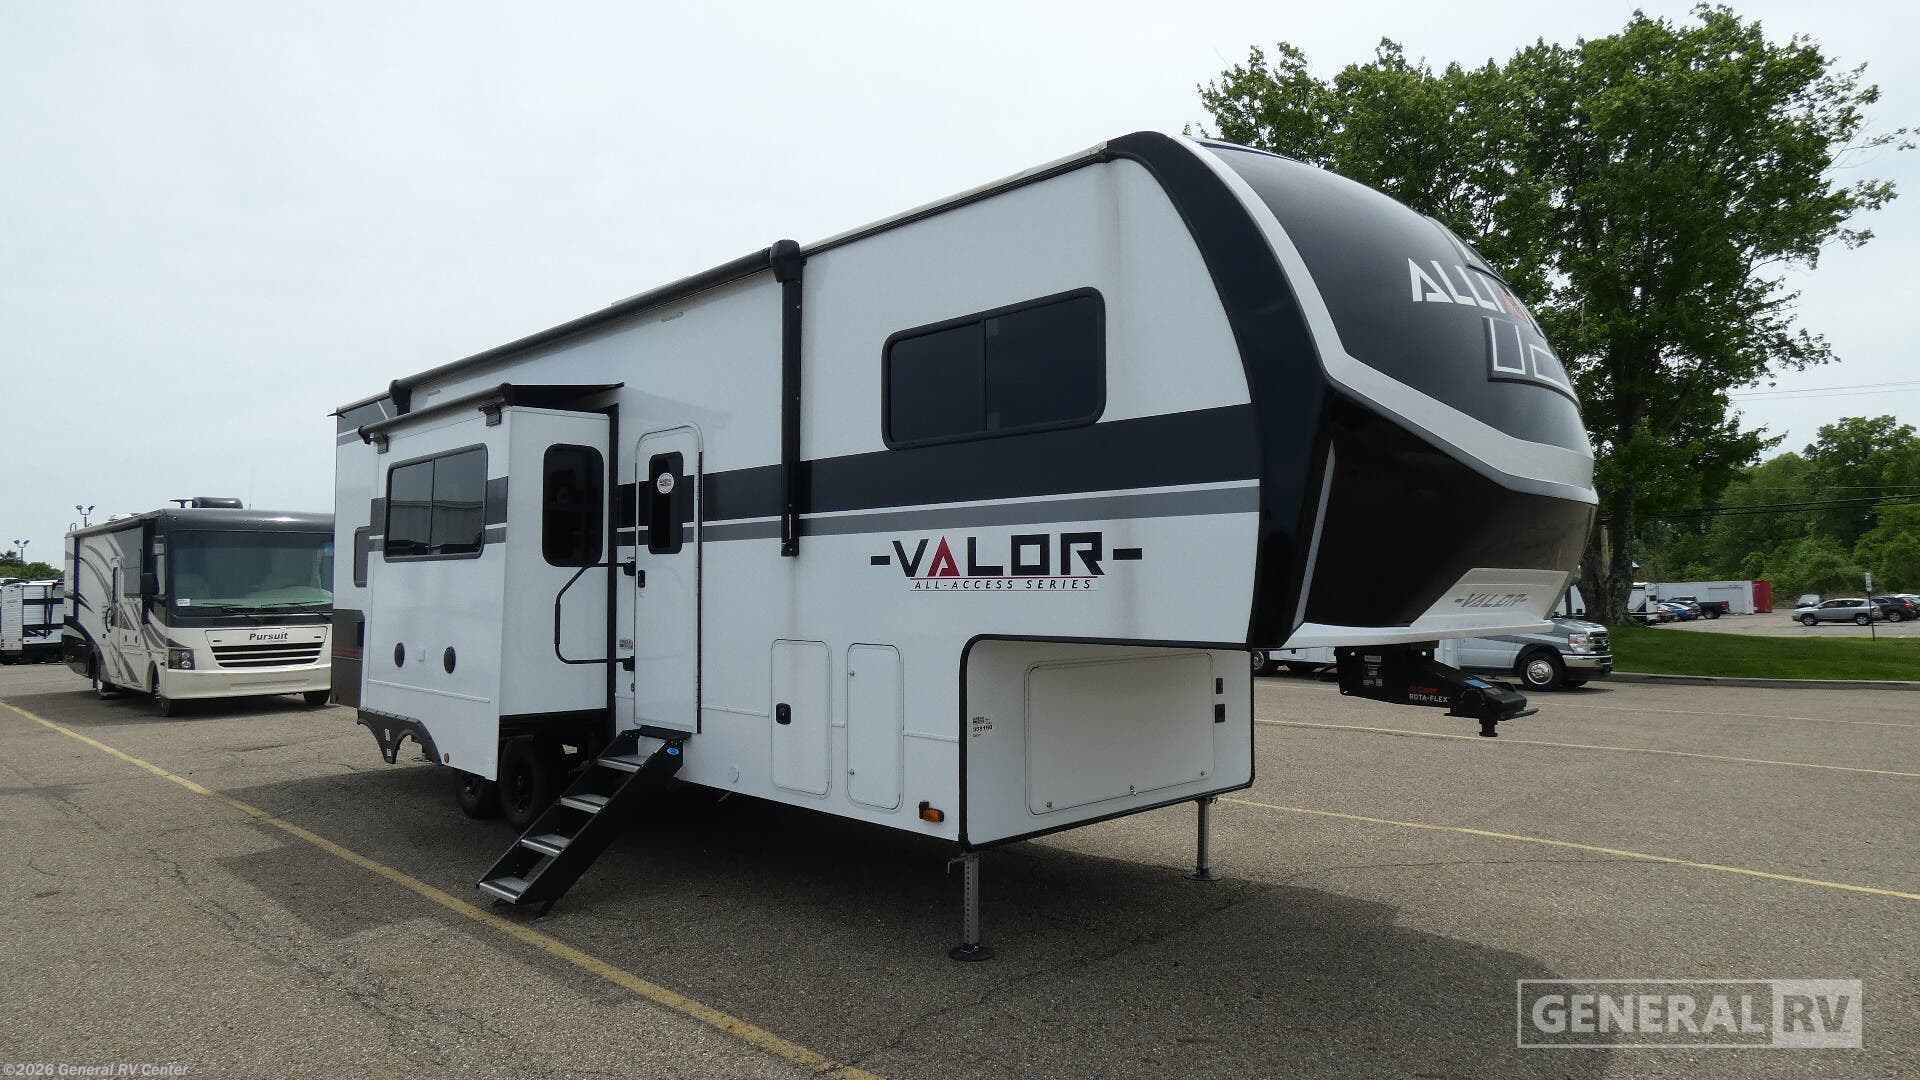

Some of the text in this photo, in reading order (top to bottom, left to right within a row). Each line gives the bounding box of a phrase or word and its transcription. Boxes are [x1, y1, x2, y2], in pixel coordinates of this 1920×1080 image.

[914, 578, 1092, 590] ALL-ACCESS SERIES
[249, 632, 288, 641] Pursuit
